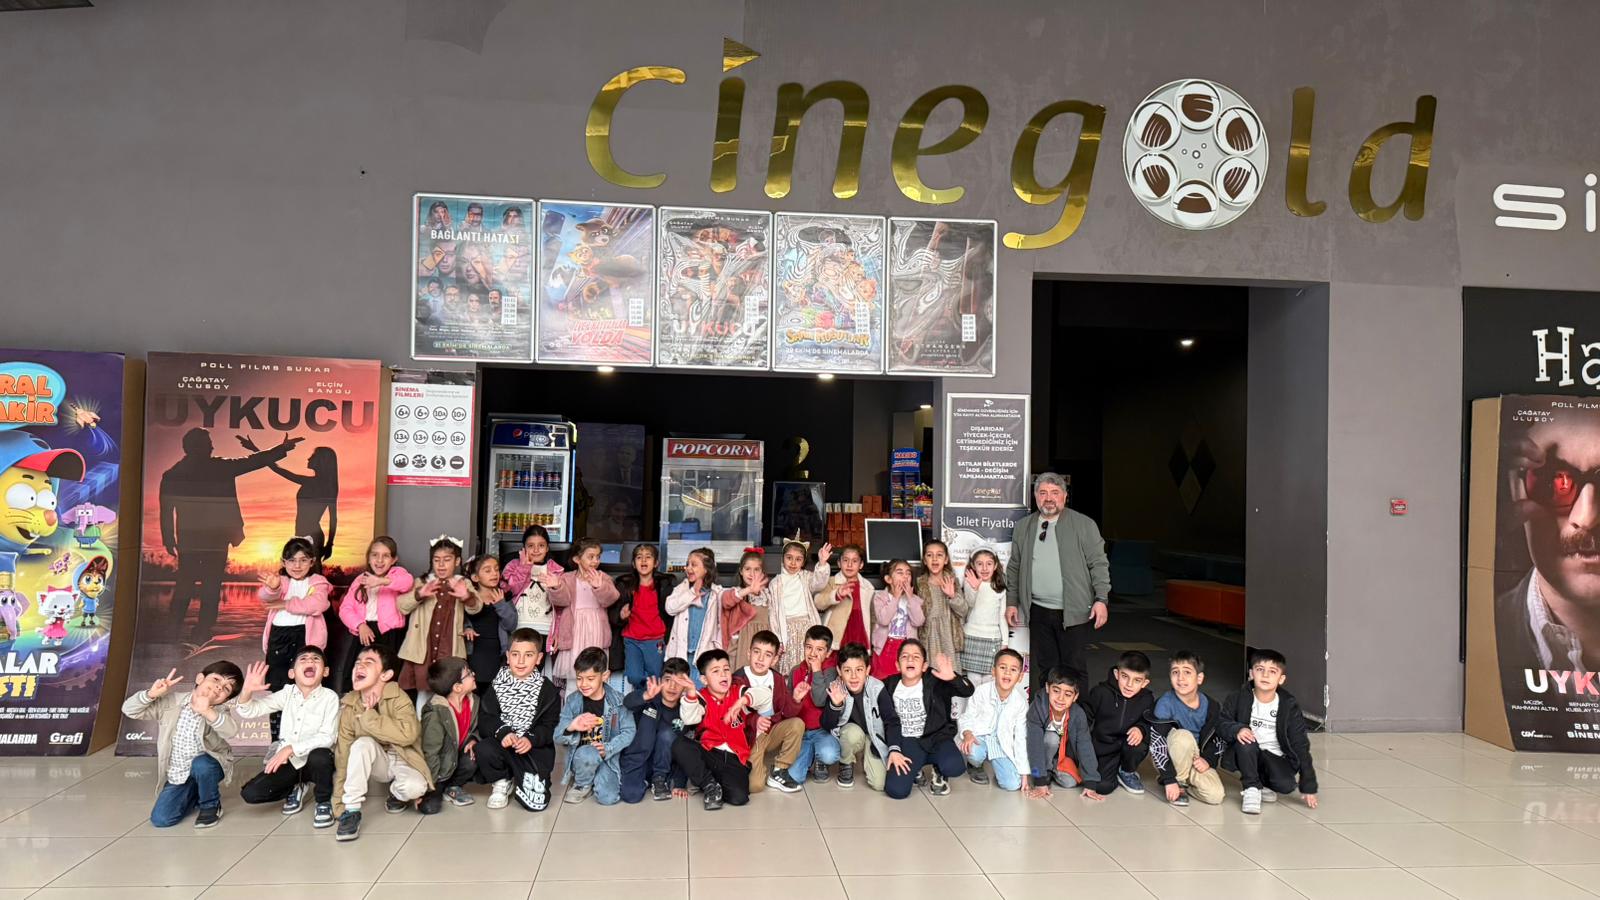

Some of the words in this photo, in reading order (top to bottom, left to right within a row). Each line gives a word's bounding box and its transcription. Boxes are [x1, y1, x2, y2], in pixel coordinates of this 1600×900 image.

[431, 229, 480, 242] BAĞLANTI
[484, 232, 520, 244] HATASI
[182, 376, 226, 384] ÇAĞATAY
[153, 392, 375, 434] UYKUCU
[672, 443, 754, 456] POPCORN
[956, 516, 978, 527] Bilet
[981, 517, 1017, 529] Fiyatla
[0, 652, 58, 674] LAR
[1524, 668, 1600, 696] UYK
[0, 734, 38, 744] ALARDA
